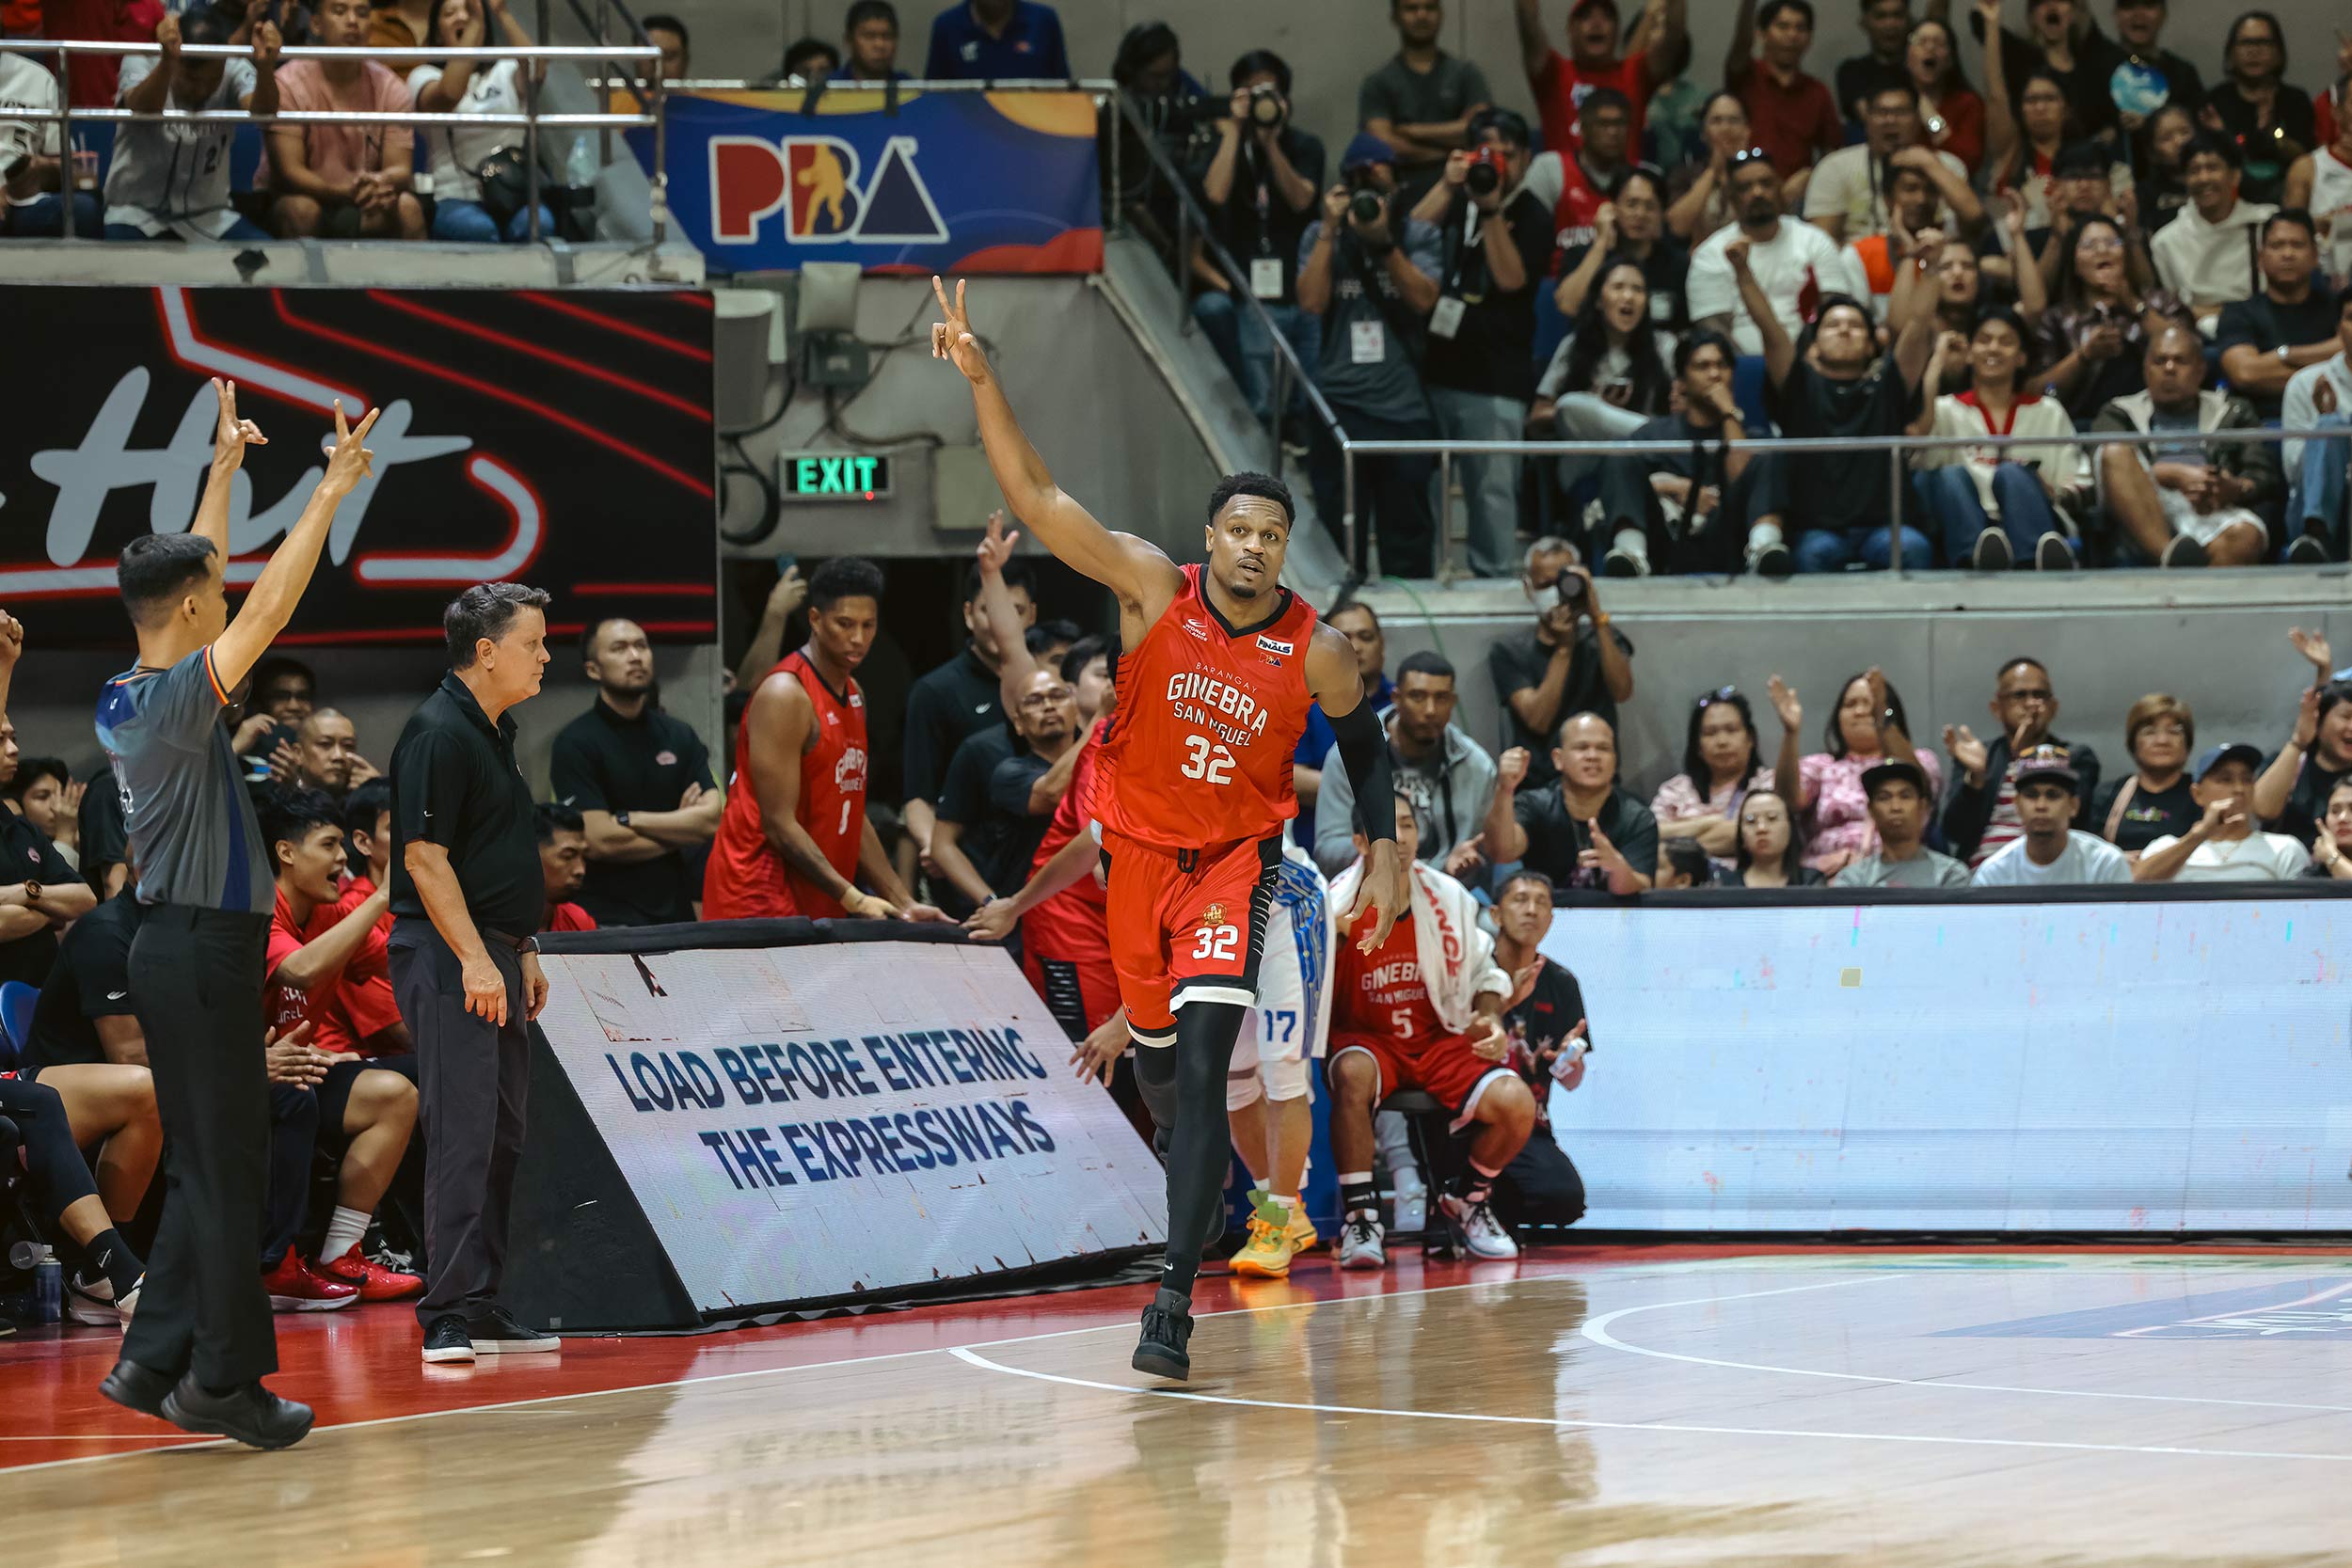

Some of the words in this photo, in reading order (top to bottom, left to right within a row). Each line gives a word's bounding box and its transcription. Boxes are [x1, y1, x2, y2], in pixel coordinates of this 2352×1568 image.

[707, 135, 950, 245] PBA
[796, 455, 878, 494] EXIT
[1185, 623, 1206, 637] WORLD
[1257, 639, 1292, 654] FINALS
[1195, 661, 1258, 695] BARANGAY
[1167, 672, 1268, 737] GINEBRA
[1173, 701, 1205, 725] SAN
[1208, 716, 1252, 747] MGUEL
[1181, 734, 1236, 785] 32
[1192, 925, 1239, 961] 32
[1264, 1009, 1295, 1042] 17
[1391, 1007, 1414, 1039] 5
[605, 1051, 725, 1112] LOAD
[713, 1039, 881, 1105] BEFORE
[861, 1026, 1048, 1092] ENTERING
[698, 1131, 798, 1190] THE
[778, 1099, 1056, 1183] EXPRESSWAYS
